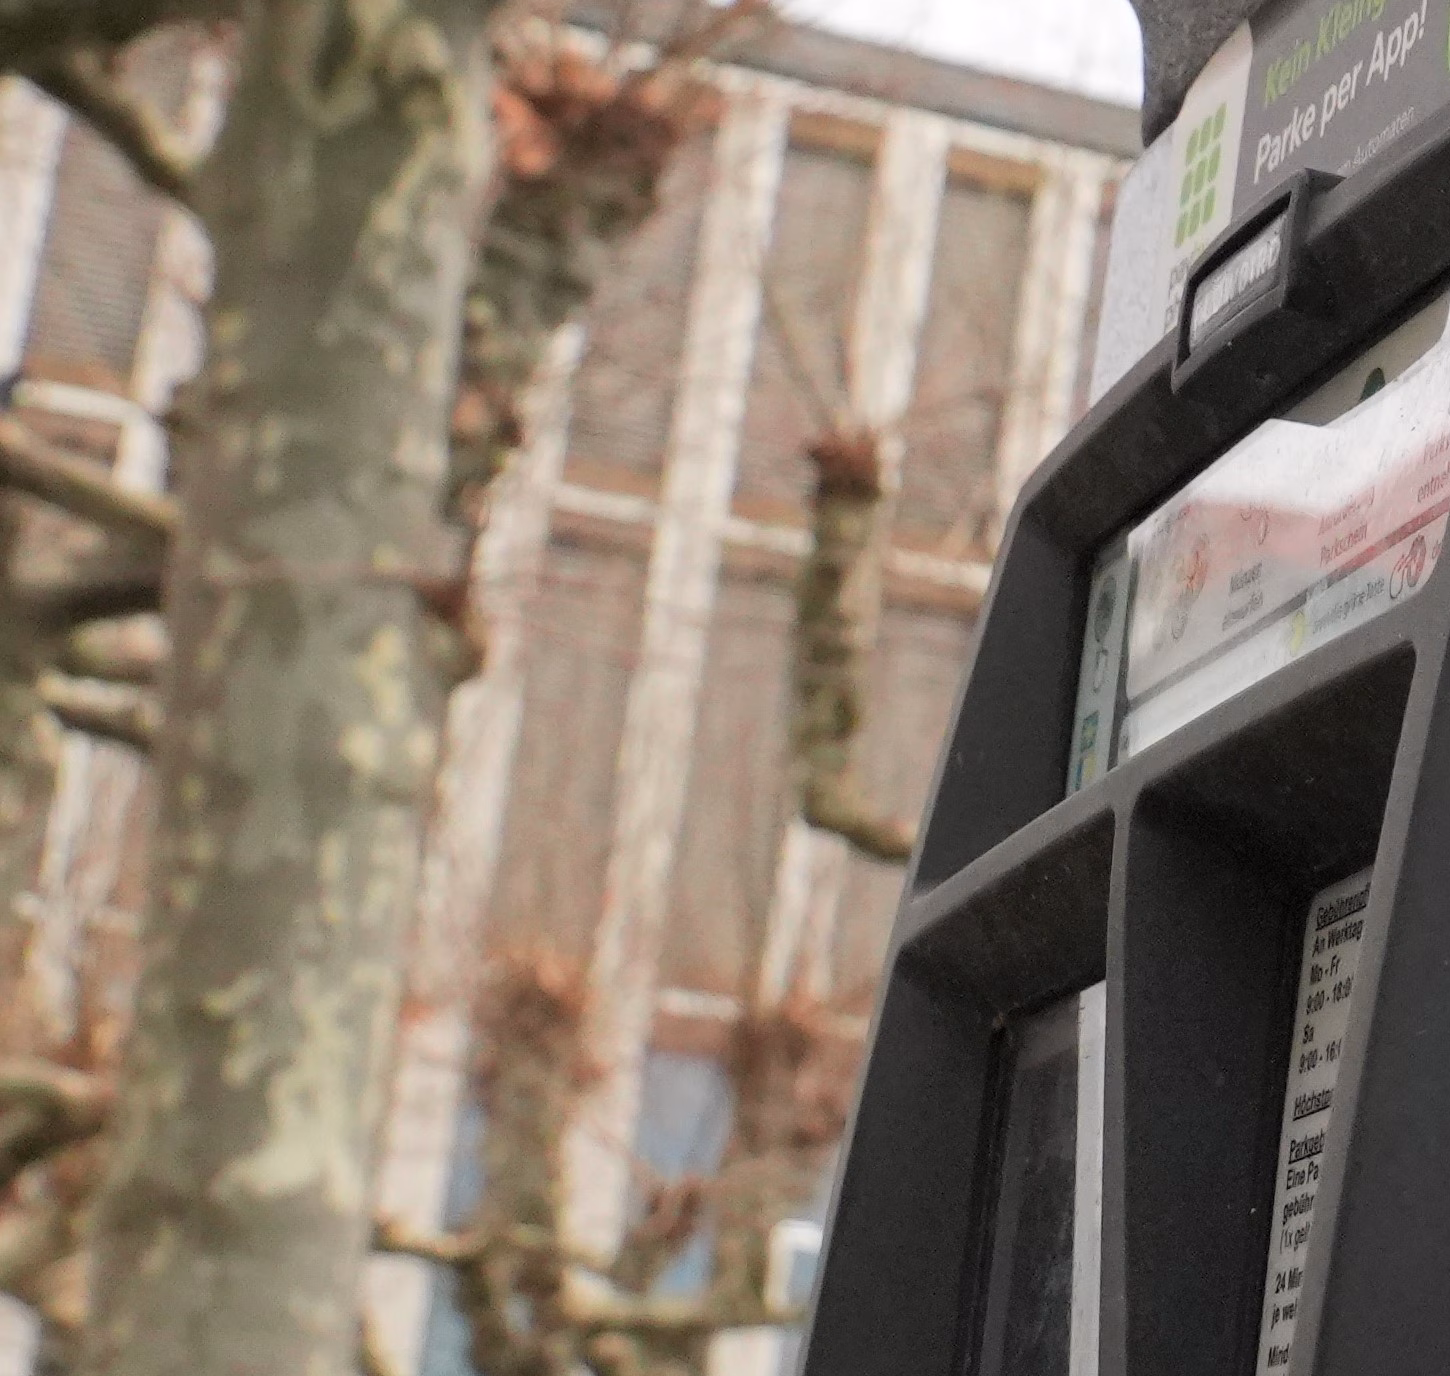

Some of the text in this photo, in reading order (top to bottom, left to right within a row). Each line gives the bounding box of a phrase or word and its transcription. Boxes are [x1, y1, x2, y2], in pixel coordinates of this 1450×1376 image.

[1263, 38, 1312, 110] Kein
[1253, 100, 1317, 184] Parke
[1319, 59, 1364, 139] per
[1310, 963, 1324, 984] Mo
[1329, 954, 1341, 977] Fr
[1286, 1169, 1306, 1191] Eine
[1282, 1191, 1315, 1227] gebühr
[1275, 1271, 1287, 1294] 24
[1270, 1303, 1280, 1332] je
[1268, 1342, 1290, 1369] Mind
